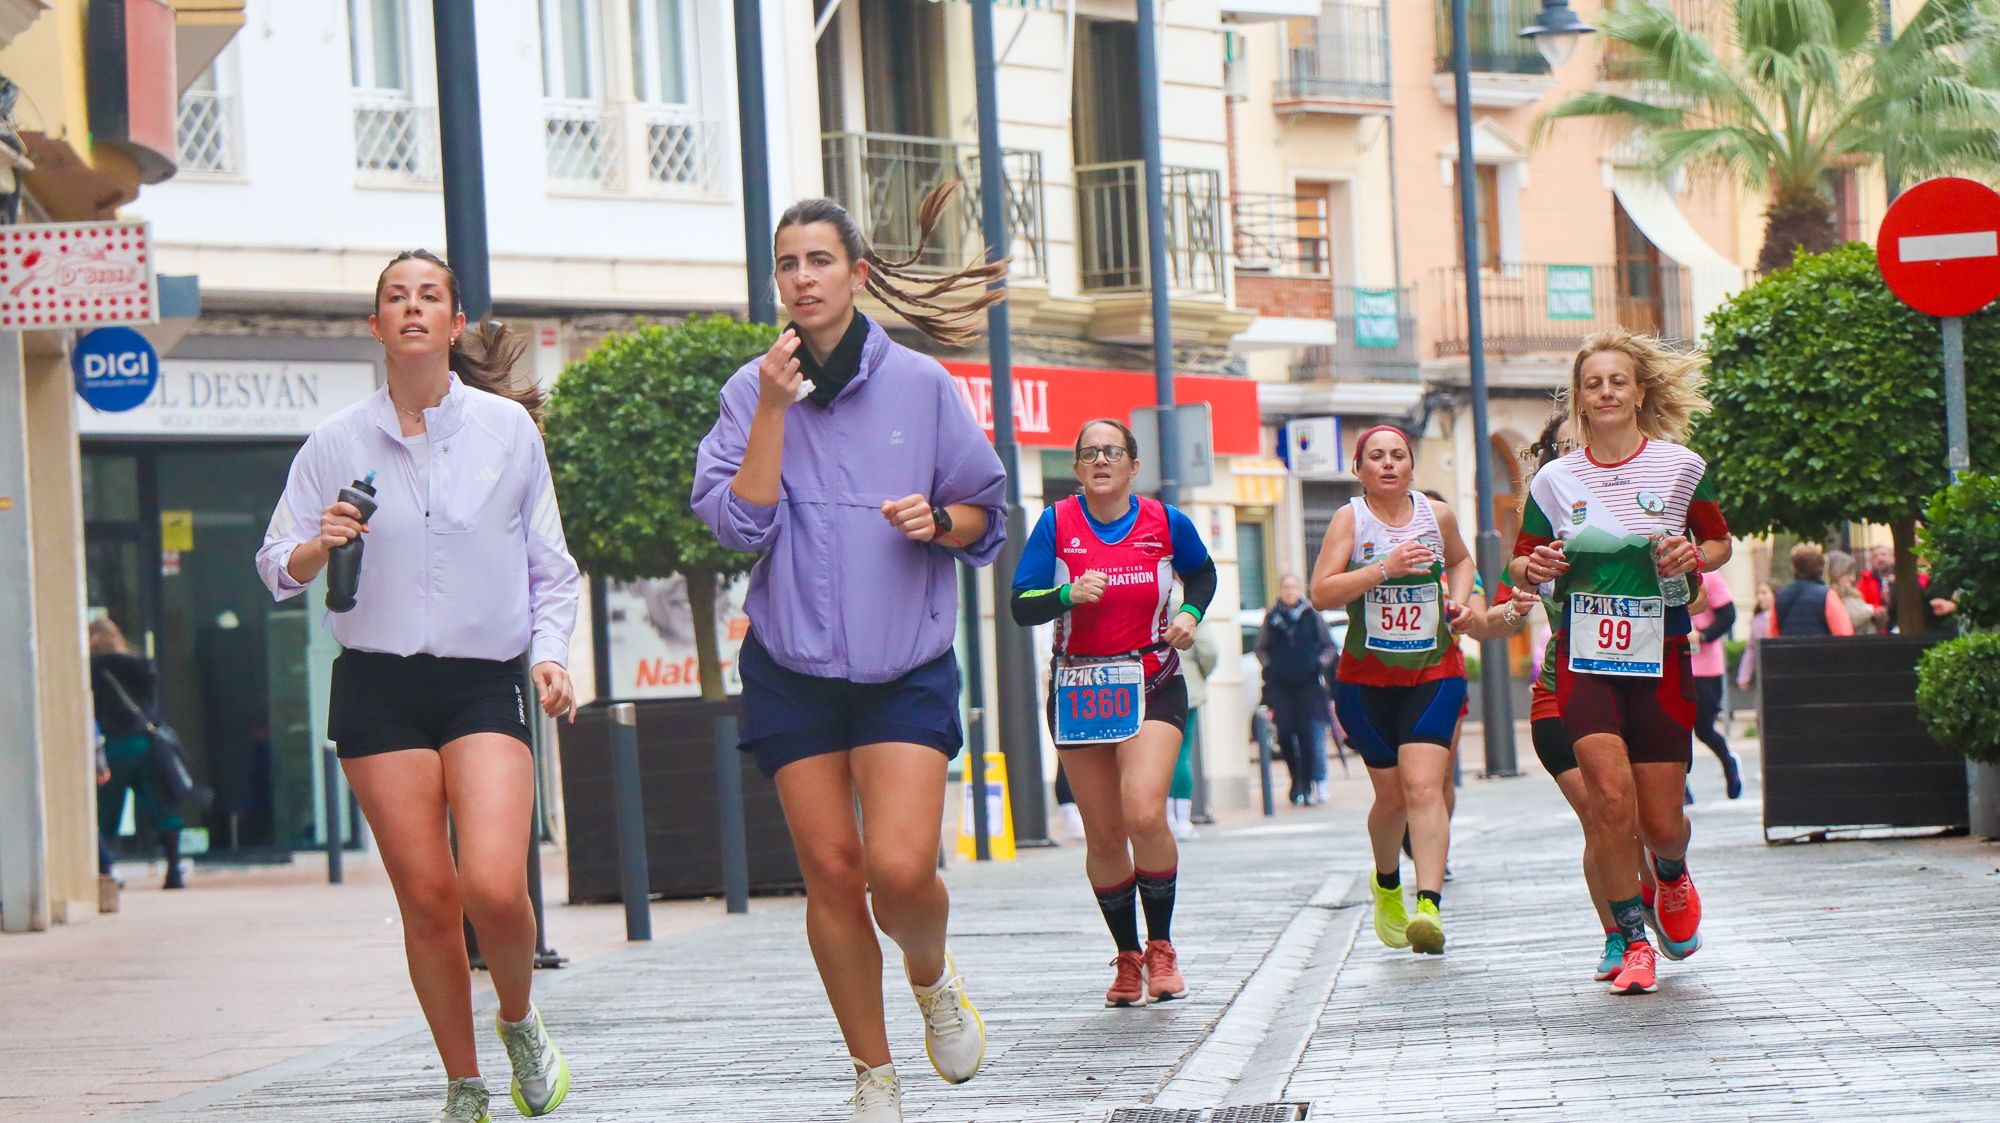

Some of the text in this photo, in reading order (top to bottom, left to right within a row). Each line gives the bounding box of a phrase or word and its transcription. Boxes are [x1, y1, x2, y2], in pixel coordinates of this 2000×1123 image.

[84, 351, 149, 379] DIGI
[188, 364, 319, 408] DESVÁN
[1381, 605, 1421, 631] 542
[1585, 596, 1614, 615] 21K
[1597, 618, 1631, 651] 99
[1067, 688, 1130, 719] 1360
